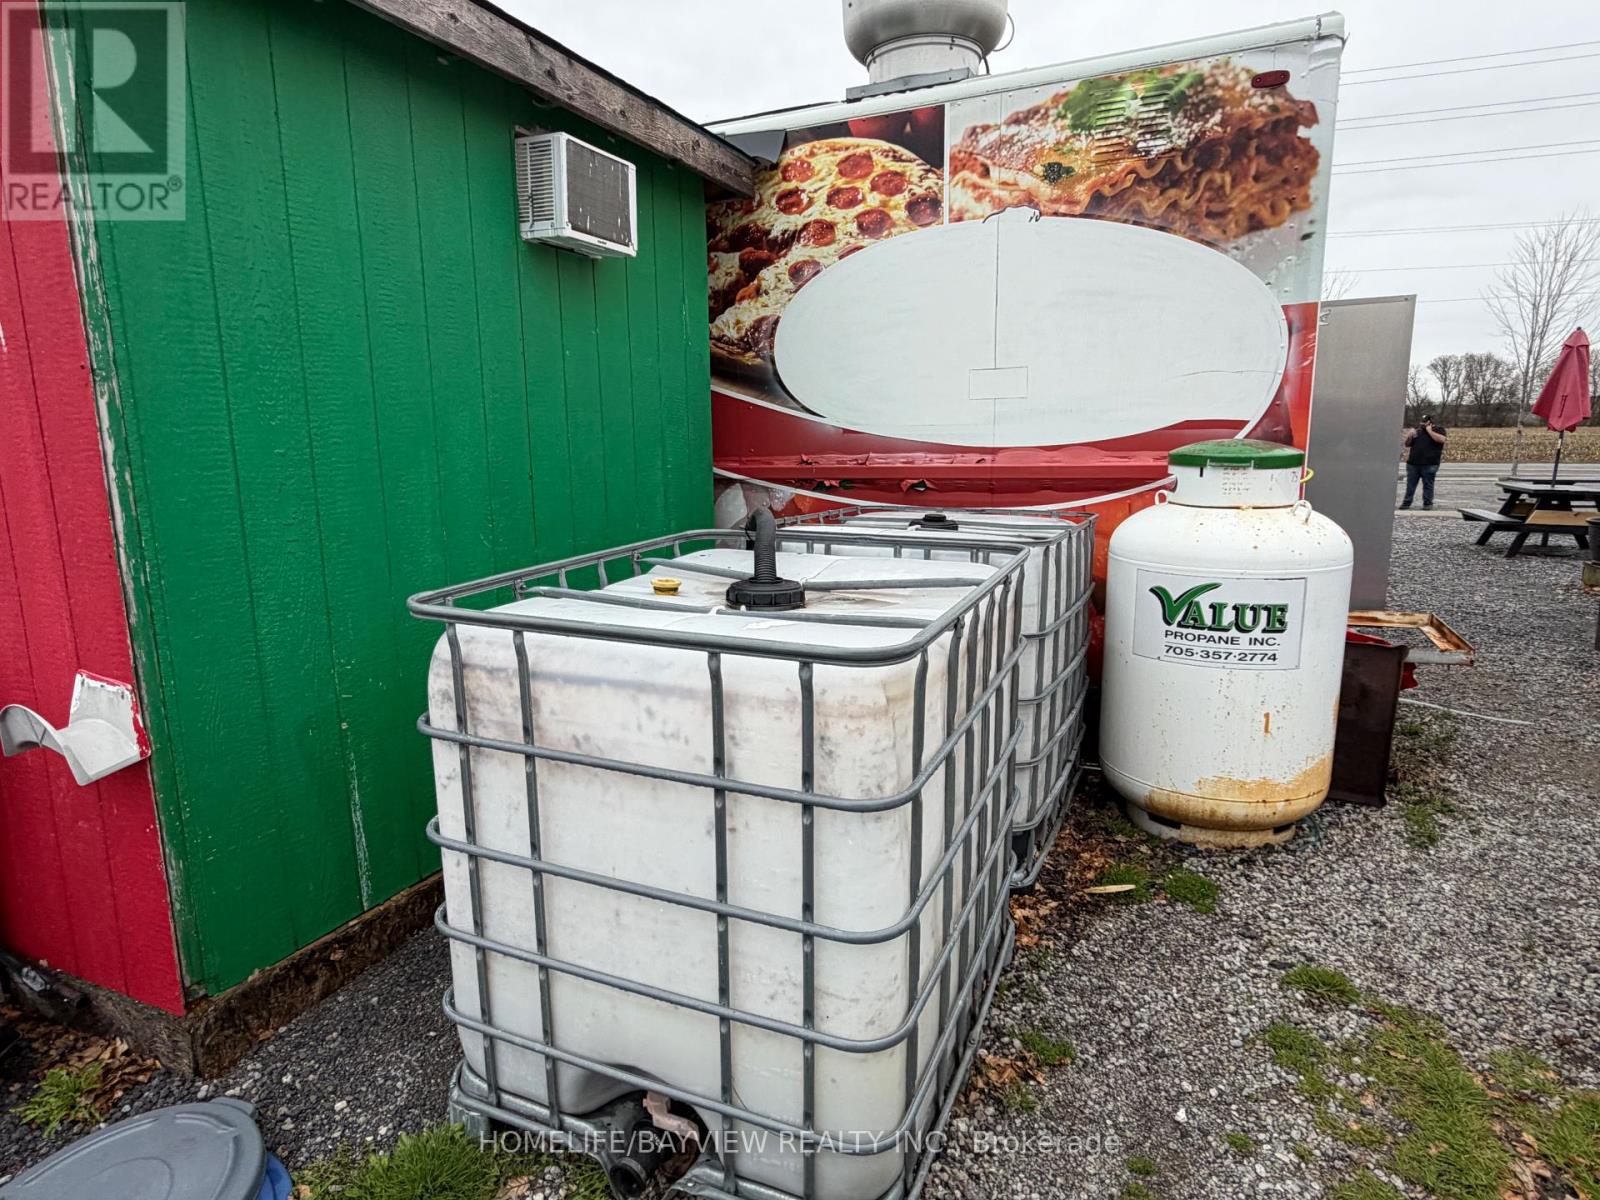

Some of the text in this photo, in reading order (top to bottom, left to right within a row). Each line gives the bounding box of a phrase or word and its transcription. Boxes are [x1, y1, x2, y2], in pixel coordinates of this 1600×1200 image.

[1149, 582, 1289, 634] VALUE
[1164, 629, 1281, 647] PROPANE INC.
